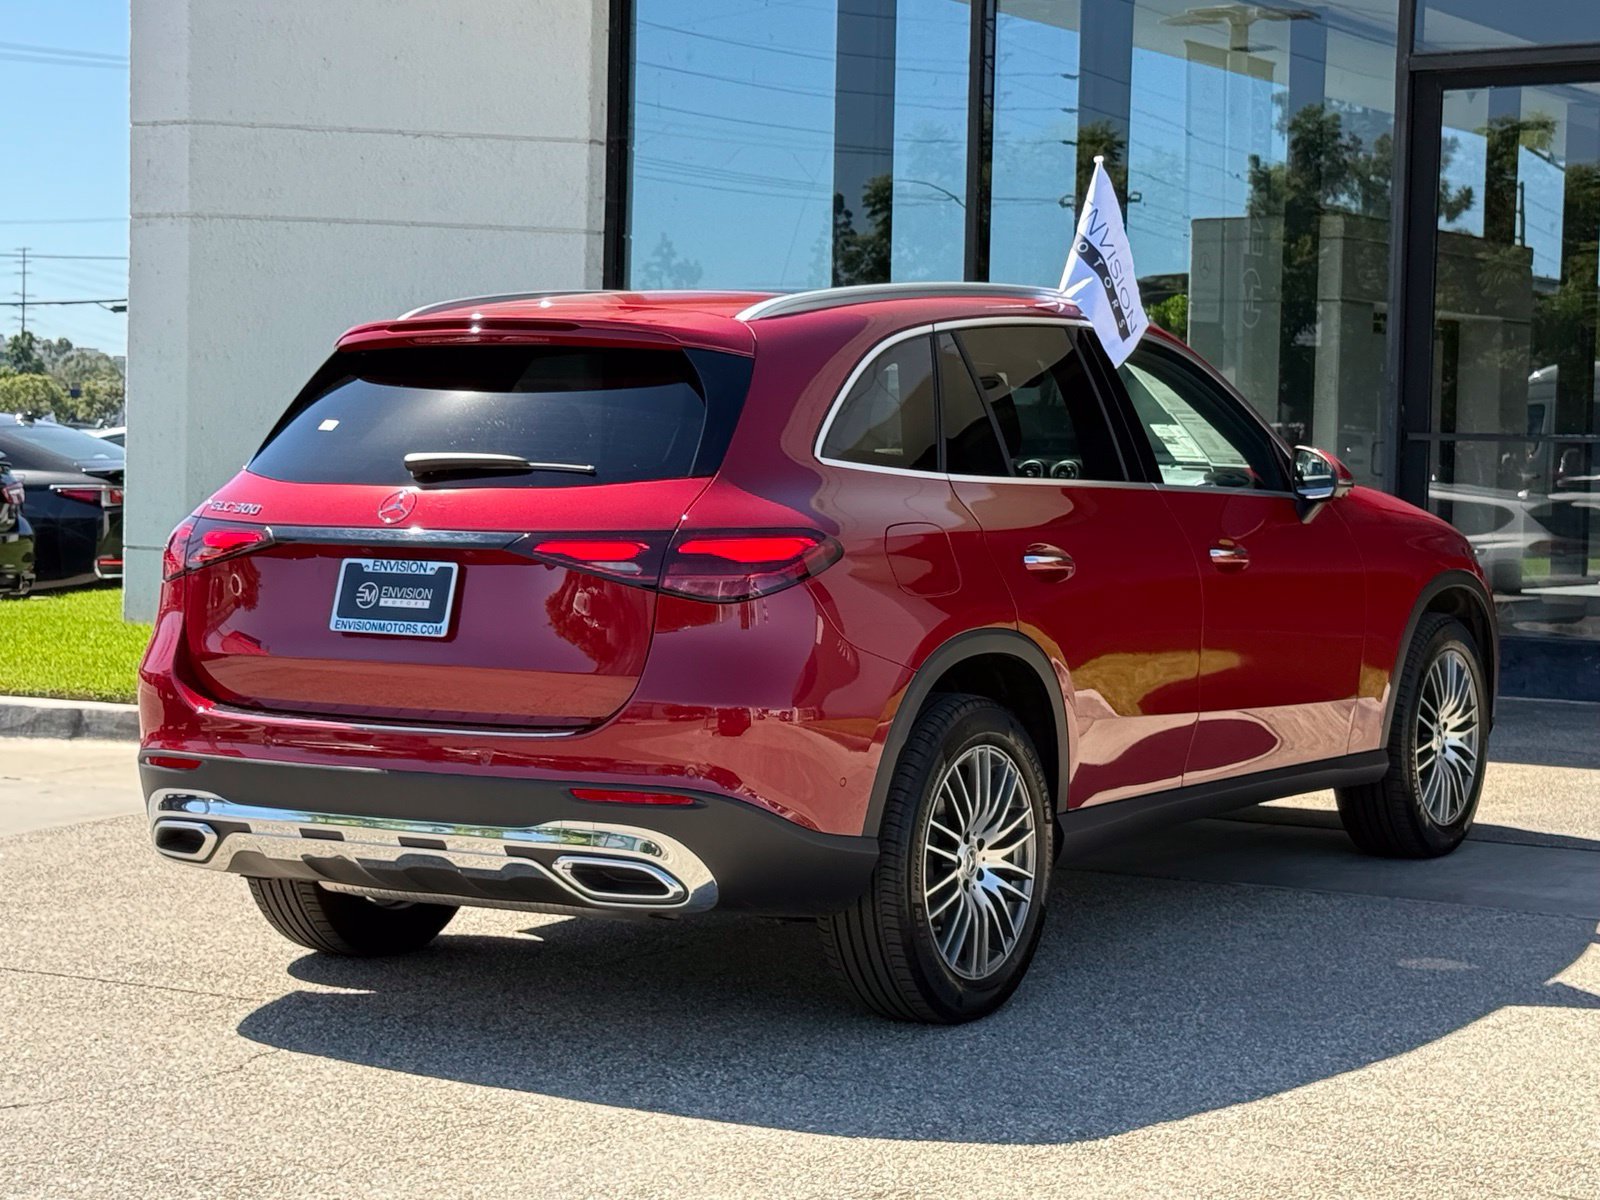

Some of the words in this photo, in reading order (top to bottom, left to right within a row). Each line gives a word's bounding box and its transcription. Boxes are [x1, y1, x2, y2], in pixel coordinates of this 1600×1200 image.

[1082, 200, 1138, 334] NVISION
[1077, 242, 1125, 329] OTORS
[211, 501, 236, 512] GLC
[233, 502, 263, 516] 300
[372, 560, 428, 573] ENVISION
[380, 586, 433, 599] ENVISION
[381, 599, 428, 608] MOTORS
[335, 619, 442, 635] ENVISIONMOTORS.COM
